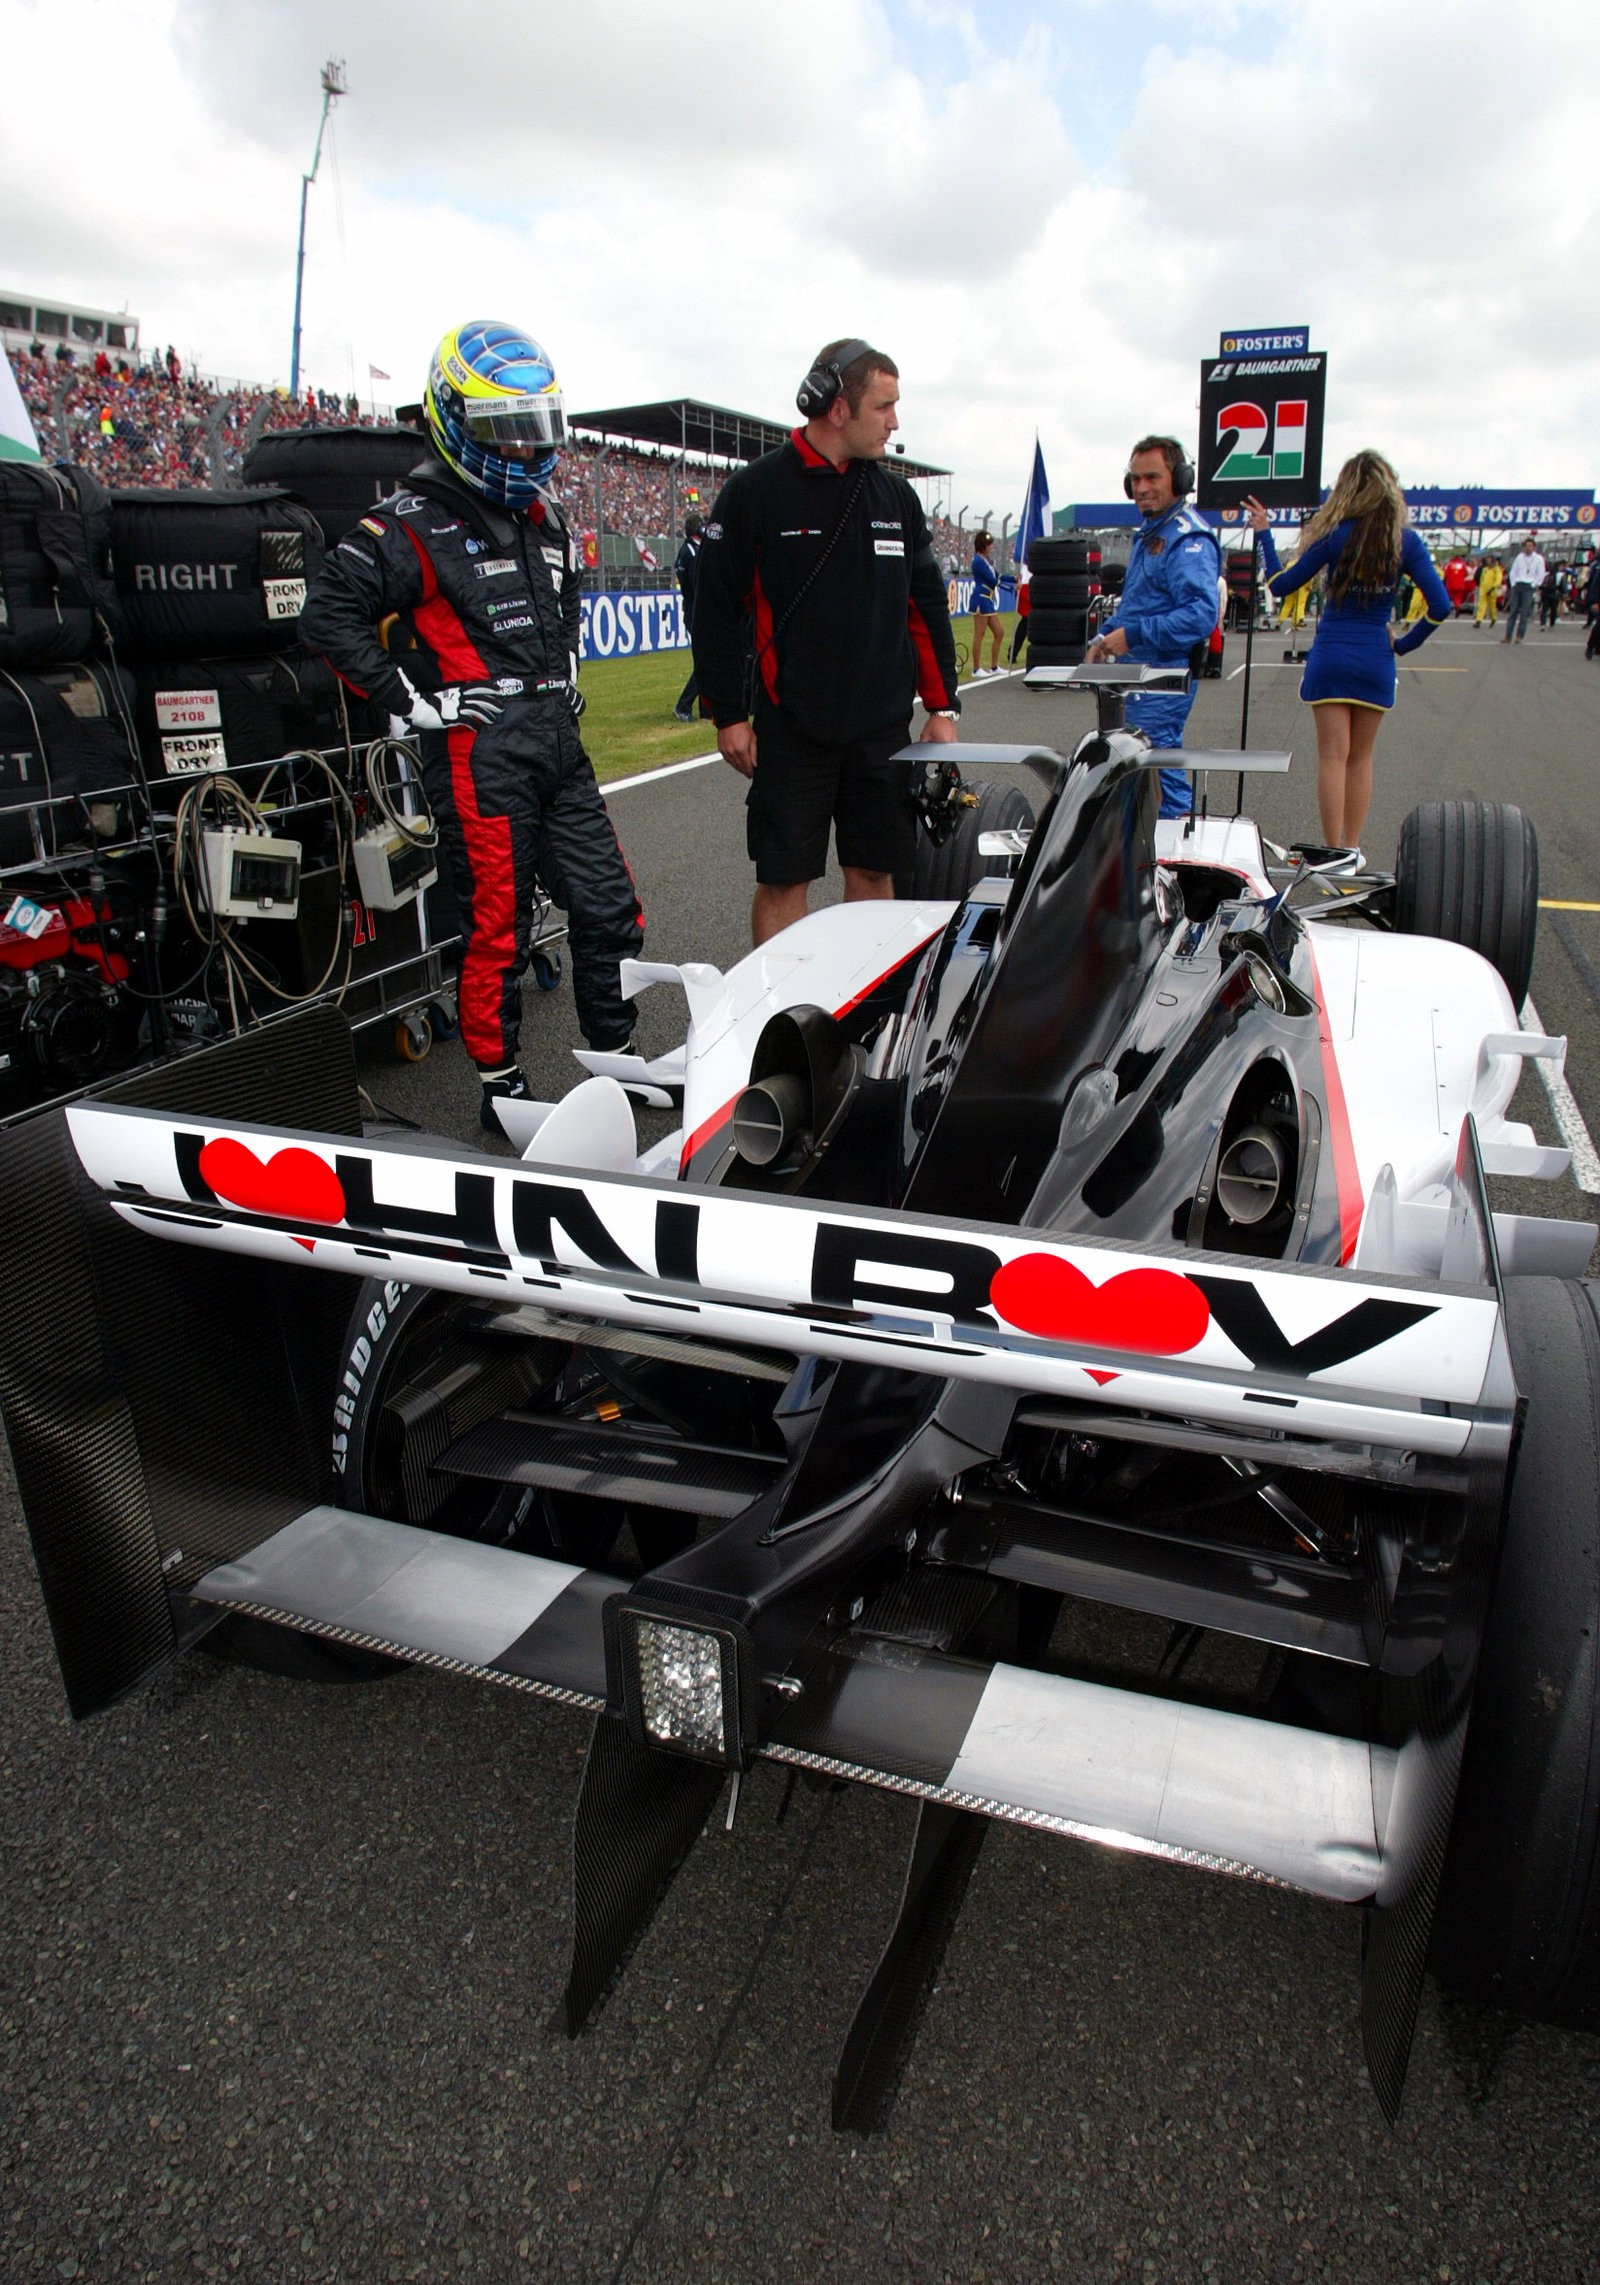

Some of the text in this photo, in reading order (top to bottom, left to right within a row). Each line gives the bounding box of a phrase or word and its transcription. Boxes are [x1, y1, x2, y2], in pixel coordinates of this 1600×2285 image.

[1235, 335, 1304, 352] FOSTER'S
[1235, 358, 1321, 376] BAUMGARTNER
[1211, 400, 1308, 481] 21
[1406, 505, 1449, 523] ER'S
[1477, 505, 1571, 523] FOSTER'S
[134, 564, 238, 590] RIGHT
[264, 583, 306, 599] FRONT
[277, 602, 302, 615] DRY
[157, 695, 215, 706] BAUMGARTNER
[171, 711, 206, 722] 2108
[163, 738, 222, 753] FRONT
[177, 756, 211, 769] DRY
